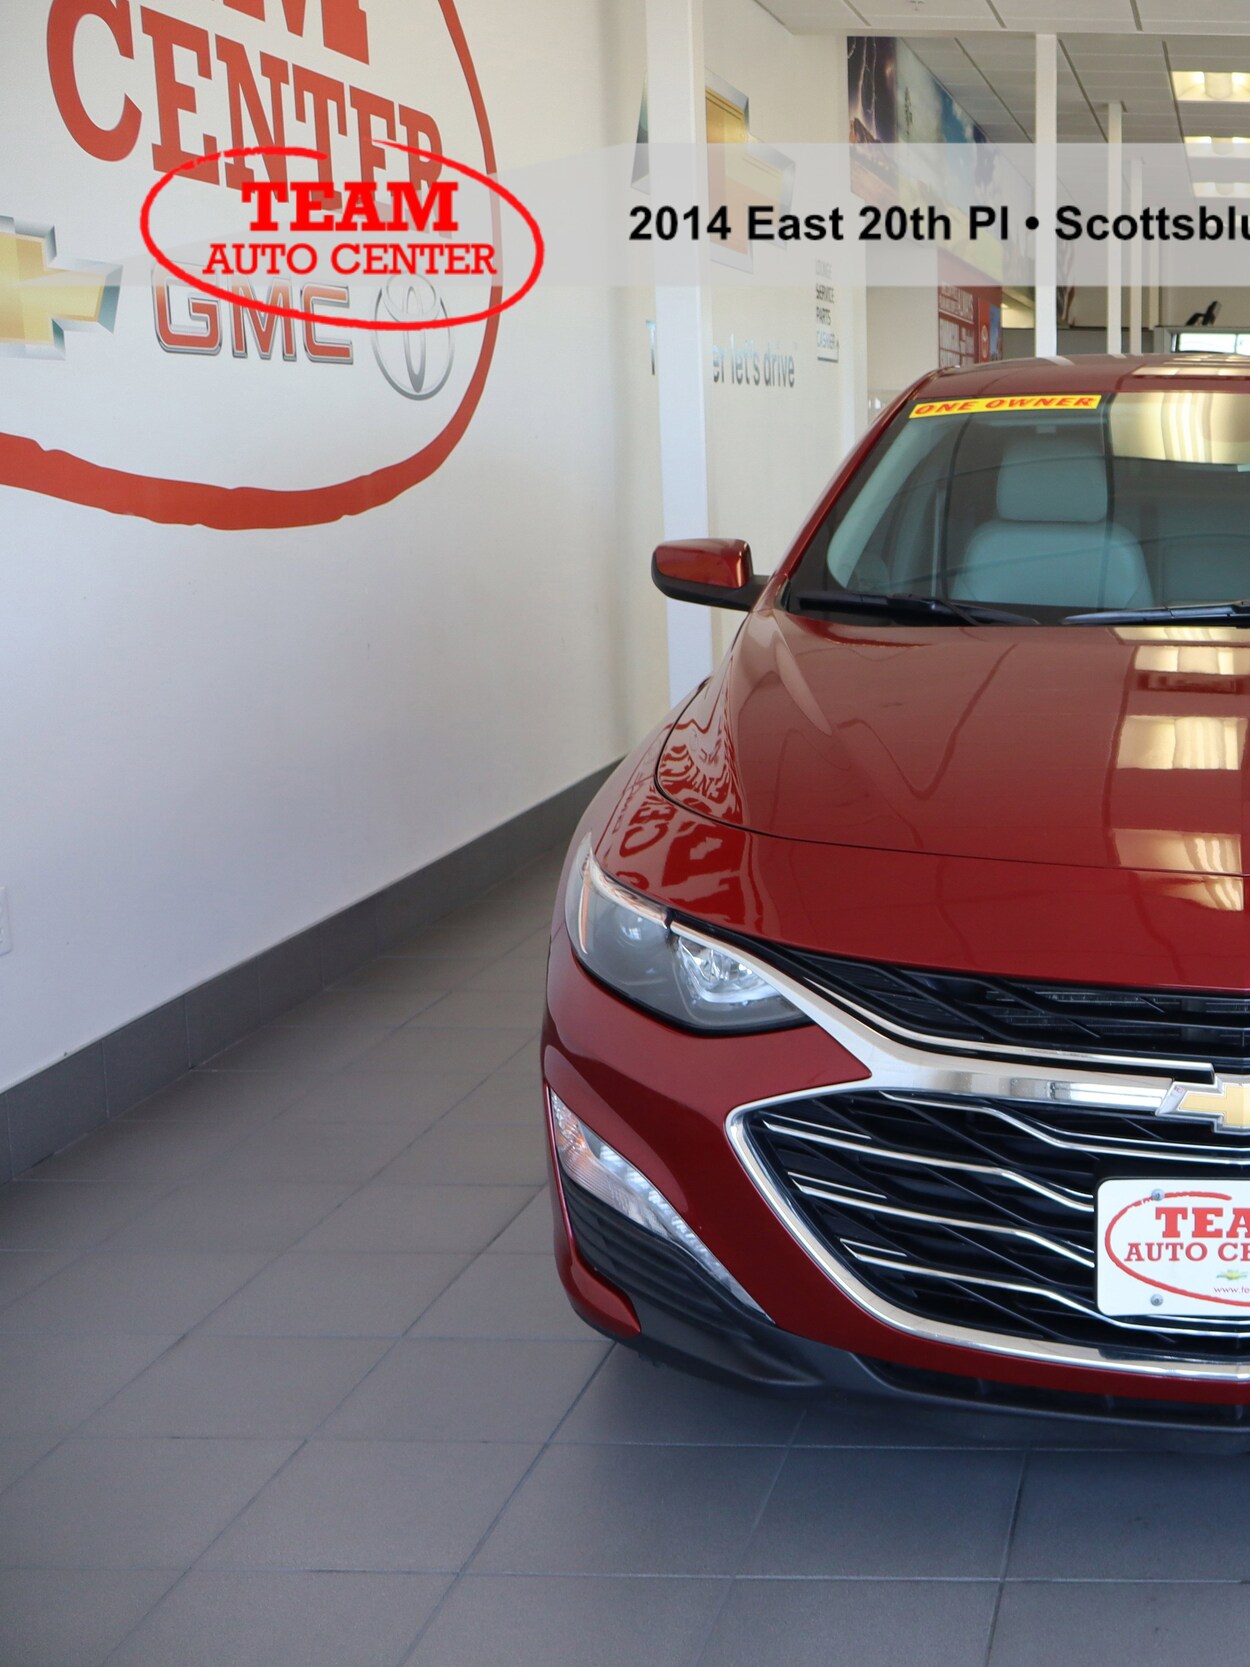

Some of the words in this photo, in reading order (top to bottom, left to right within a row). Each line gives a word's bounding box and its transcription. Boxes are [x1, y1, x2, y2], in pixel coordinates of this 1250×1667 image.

[46, 0, 453, 239] CENTER
[151, 262, 354, 364] GMC
[763, 341, 795, 388] drive
[914, 401, 976, 416] ONE
[985, 396, 1096, 409] OWNER
[1124, 1242, 1208, 1263] AUTO
